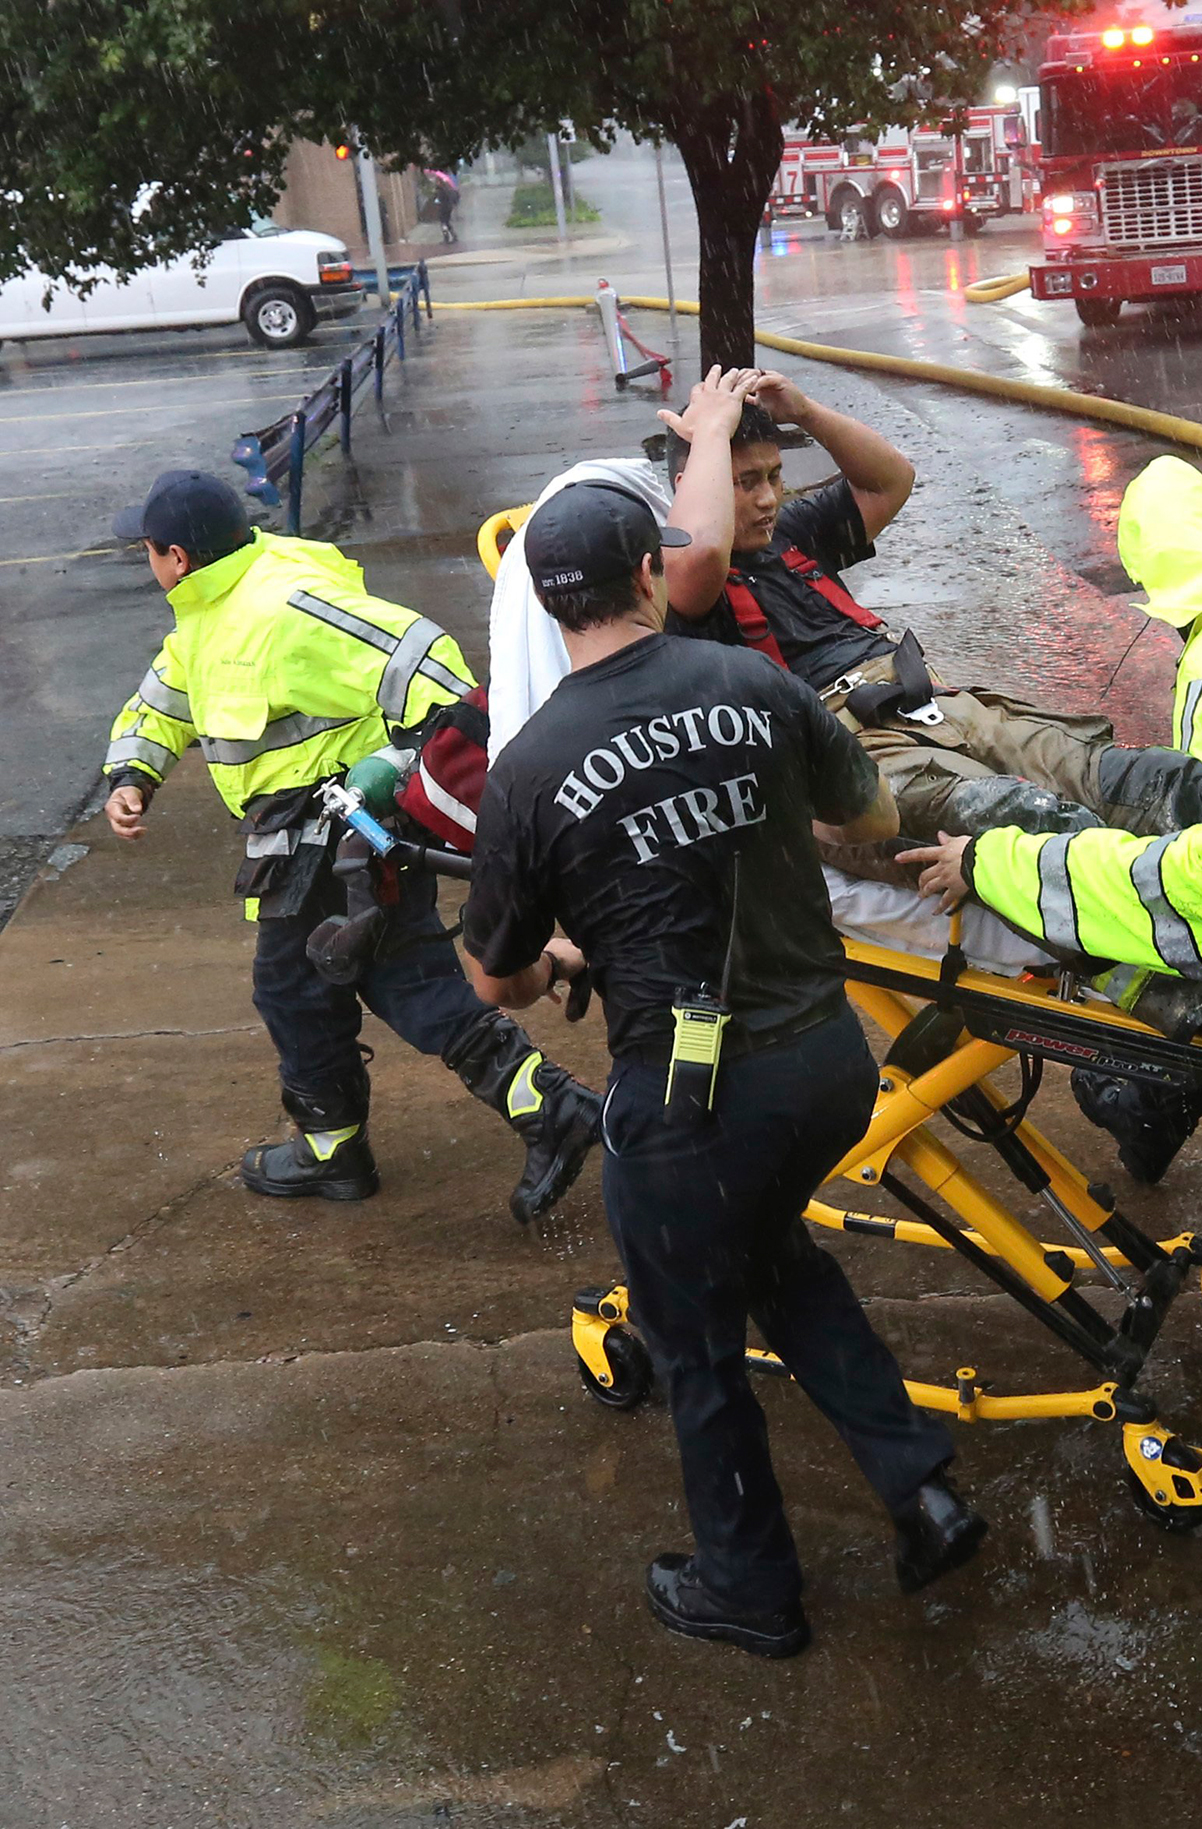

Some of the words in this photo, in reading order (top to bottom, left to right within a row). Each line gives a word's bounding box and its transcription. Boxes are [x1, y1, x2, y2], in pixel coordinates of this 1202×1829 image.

[786, 170, 798, 194] 7
[555, 570, 584, 585] 1838
[554, 704, 773, 824] HOUSTON
[616, 772, 767, 865] FIRE
[1004, 1028, 1099, 1059] power
[1096, 1055, 1139, 1072] pro
